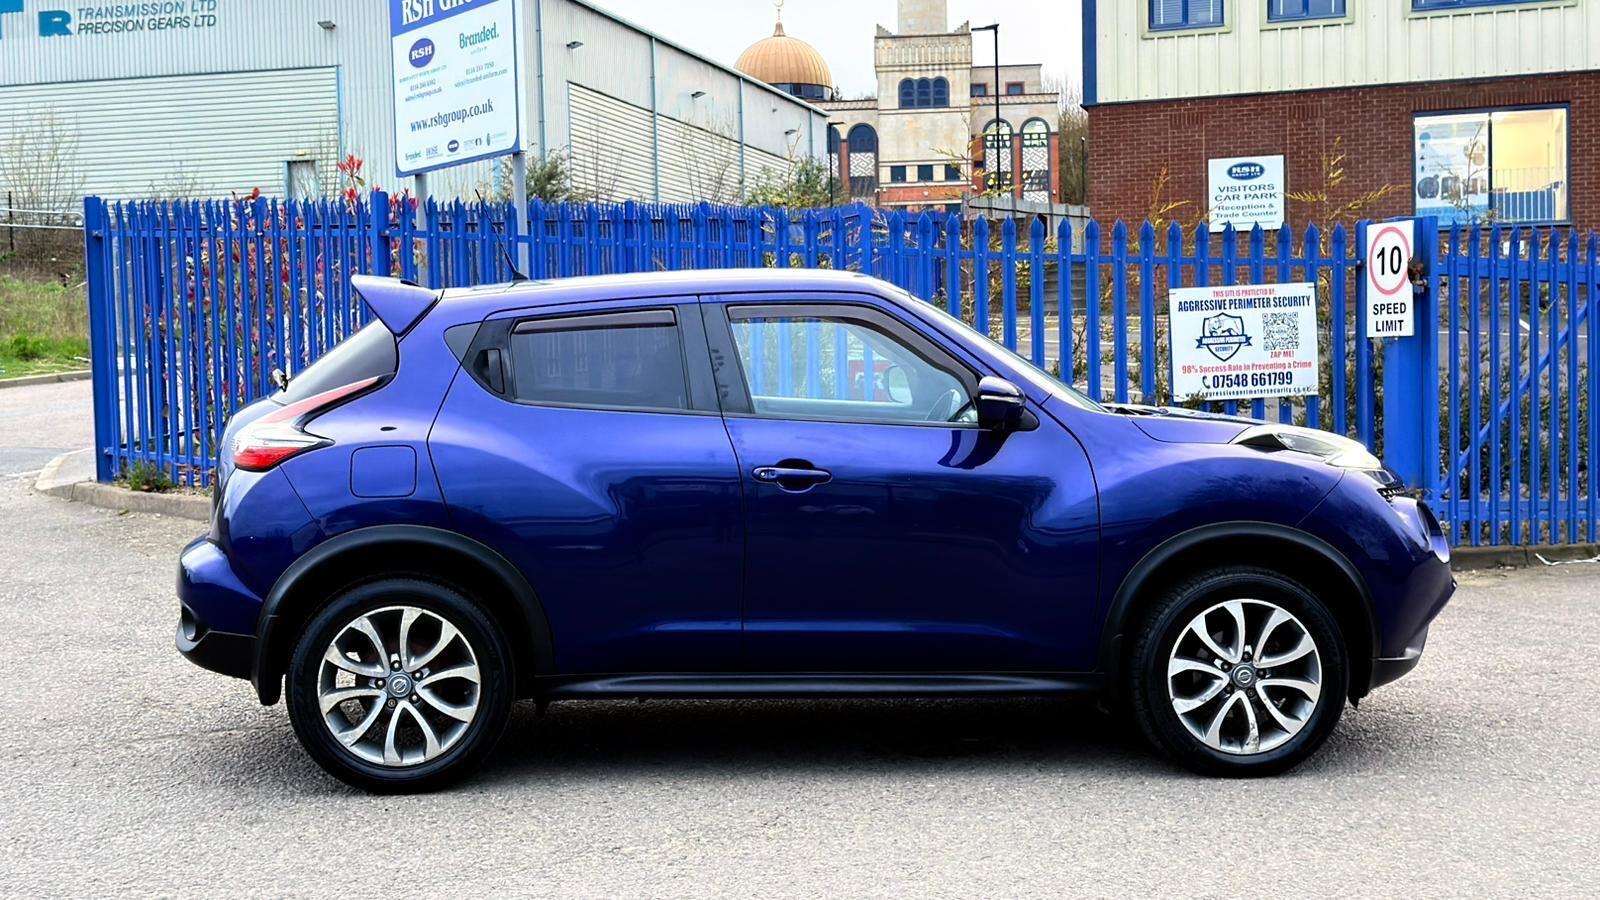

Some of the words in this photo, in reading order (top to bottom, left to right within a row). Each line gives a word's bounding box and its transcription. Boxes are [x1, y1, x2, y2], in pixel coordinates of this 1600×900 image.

[77, 2, 185, 20] TRANSMISSION
[191, 0, 217, 12] LTD
[77, 19, 145, 35] PRECISION
[147, 16, 191, 31] GEARS
[193, 15, 217, 27] LTD
[459, 21, 500, 49] Branded.
[410, 45, 433, 60] RSH
[410, 98, 494, 132] www.rshgroup.co.uk
[1218, 184, 1275, 193] VISITORS
[1214, 193, 1241, 202] CAR
[1244, 192, 1278, 200] PARK
[1217, 203, 1266, 212] Reception
[1241, 210, 1278, 218] Counter
[1376, 245, 1402, 276] 10
[1213, 290, 1224, 298] THIS
[1241, 288, 1268, 297] PROTECTED
[1178, 299, 1227, 312] AGGRESSIVE
[1228, 297, 1271, 310] PERIMETER
[1272, 295, 1311, 308] SECURITY
[1372, 302, 1407, 316] SPEED
[1375, 319, 1405, 333] LIMIT
[1270, 351, 1281, 359] ZAP
[1181, 364, 1198, 375] 98%
[1199, 364, 1227, 374] Success
[1227, 363, 1243, 372] Rate
[1251, 361, 1287, 371] Preventing
[1292, 360, 1312, 369] Crime
[1212, 373, 1249, 389] 07548
[1251, 371, 1293, 387] 661799
